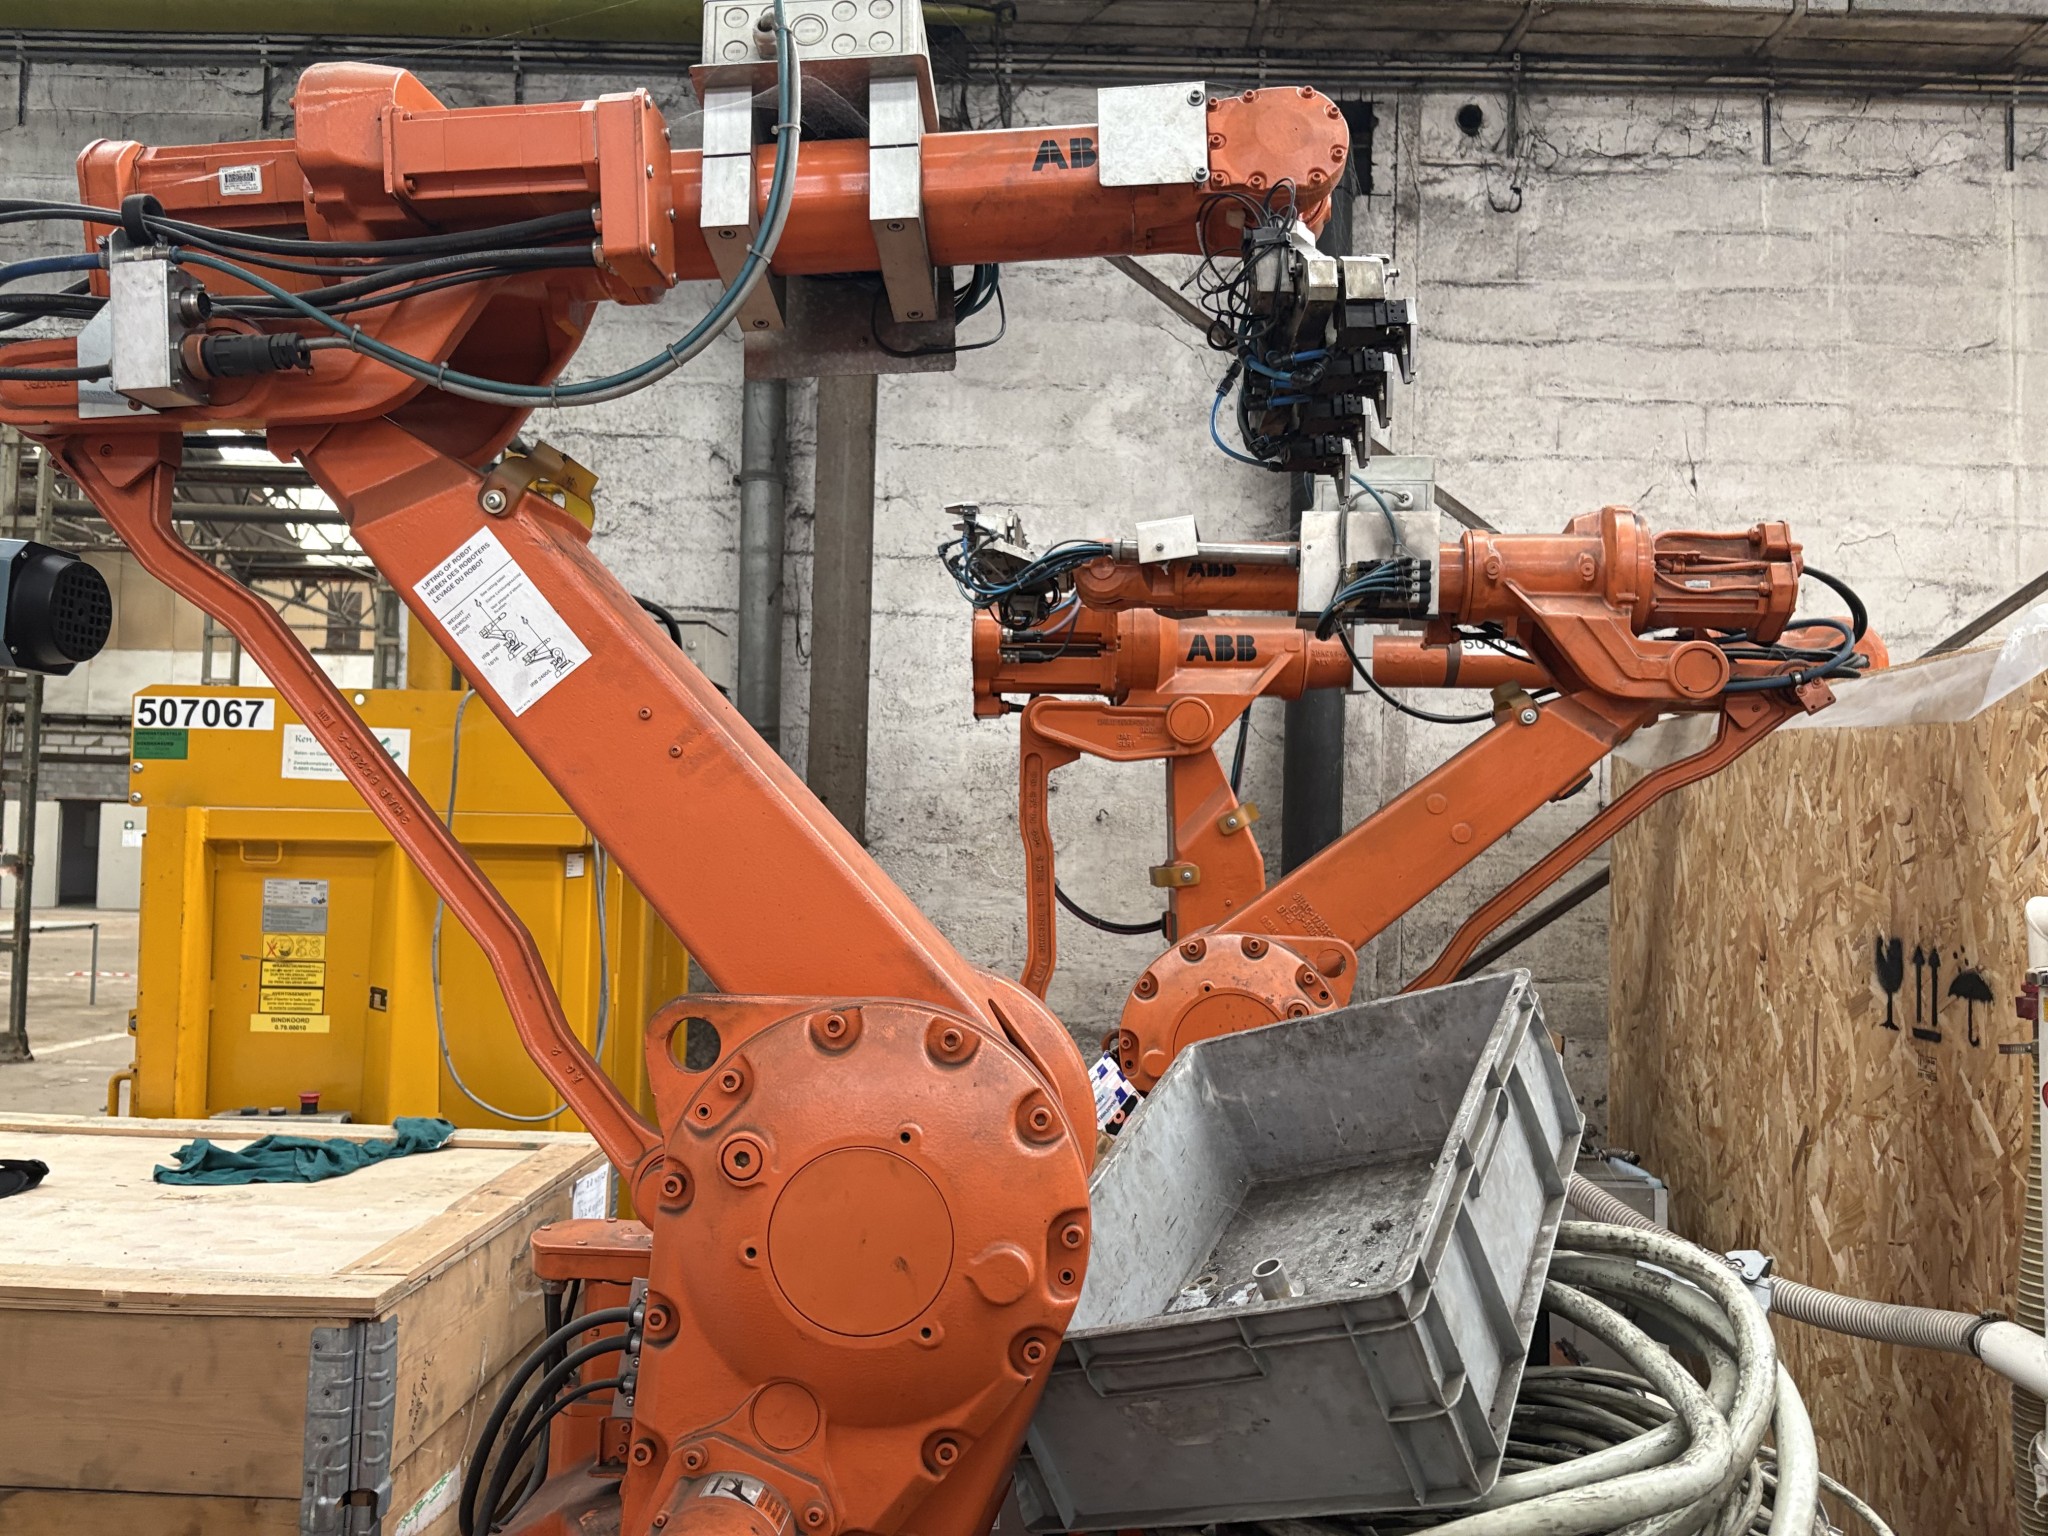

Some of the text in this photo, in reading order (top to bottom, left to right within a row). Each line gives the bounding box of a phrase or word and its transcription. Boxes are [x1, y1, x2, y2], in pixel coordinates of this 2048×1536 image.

[1032, 137, 1096, 171] AB
[422, 546, 472, 589] LIFTING OF ROBOT
[427, 542, 490, 596] HEBEN DES ROBOTERS
[432, 559, 484, 603] LEVAGE DU ROBOT
[447, 610, 464, 625] WEIGHT
[451, 614, 471, 631] GEWICHT
[456, 624, 470, 636] POIDS
[1186, 634, 1257, 662] ABB
[138, 699, 264, 727] 507067
[295, 734, 312, 743] Ken
